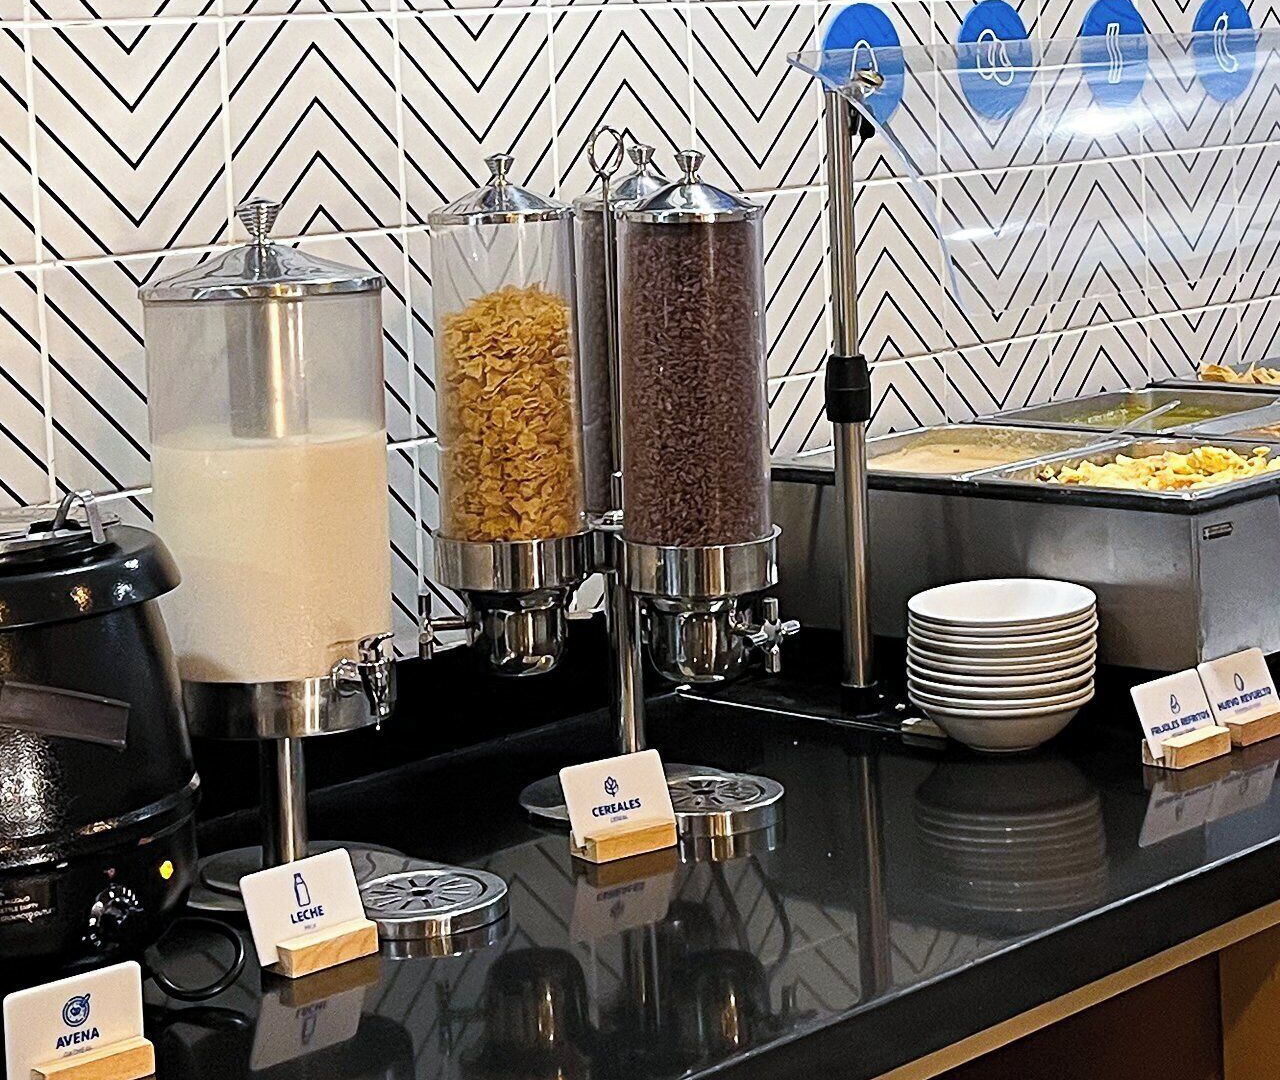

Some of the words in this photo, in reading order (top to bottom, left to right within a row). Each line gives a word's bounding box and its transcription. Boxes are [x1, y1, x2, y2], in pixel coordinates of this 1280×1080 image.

[592, 798, 641, 817] CEREALES
[290, 905, 325, 924] LECHE
[55, 1027, 100, 1049] AVENA
